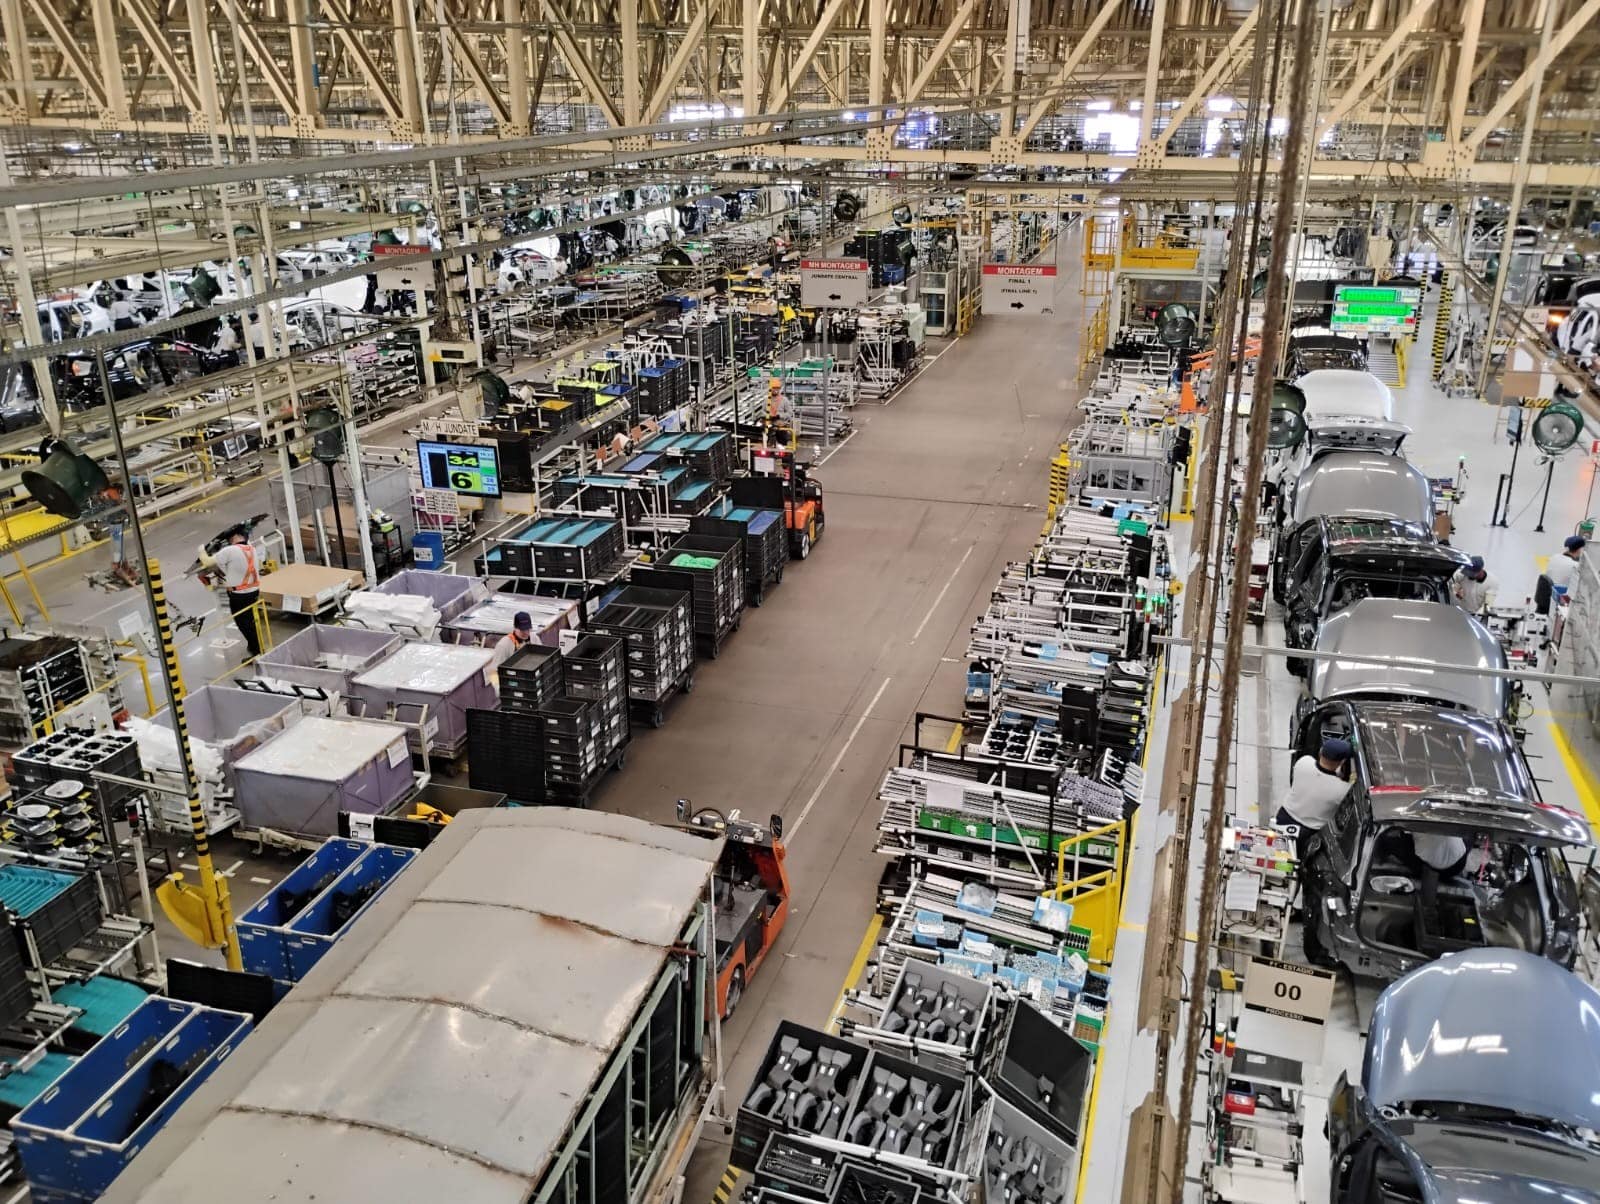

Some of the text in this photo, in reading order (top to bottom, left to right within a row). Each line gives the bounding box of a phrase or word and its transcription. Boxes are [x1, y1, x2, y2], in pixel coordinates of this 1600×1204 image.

[384, 247, 421, 255] MONTAGEM
[820, 262, 861, 270] MONTAGEM
[997, 267, 1044, 275] MONTAGEM
[445, 421, 478, 435] JUNDATE
[448, 455, 479, 467] 34
[451, 472, 473, 489] 6
[1274, 981, 1302, 1001] 00
